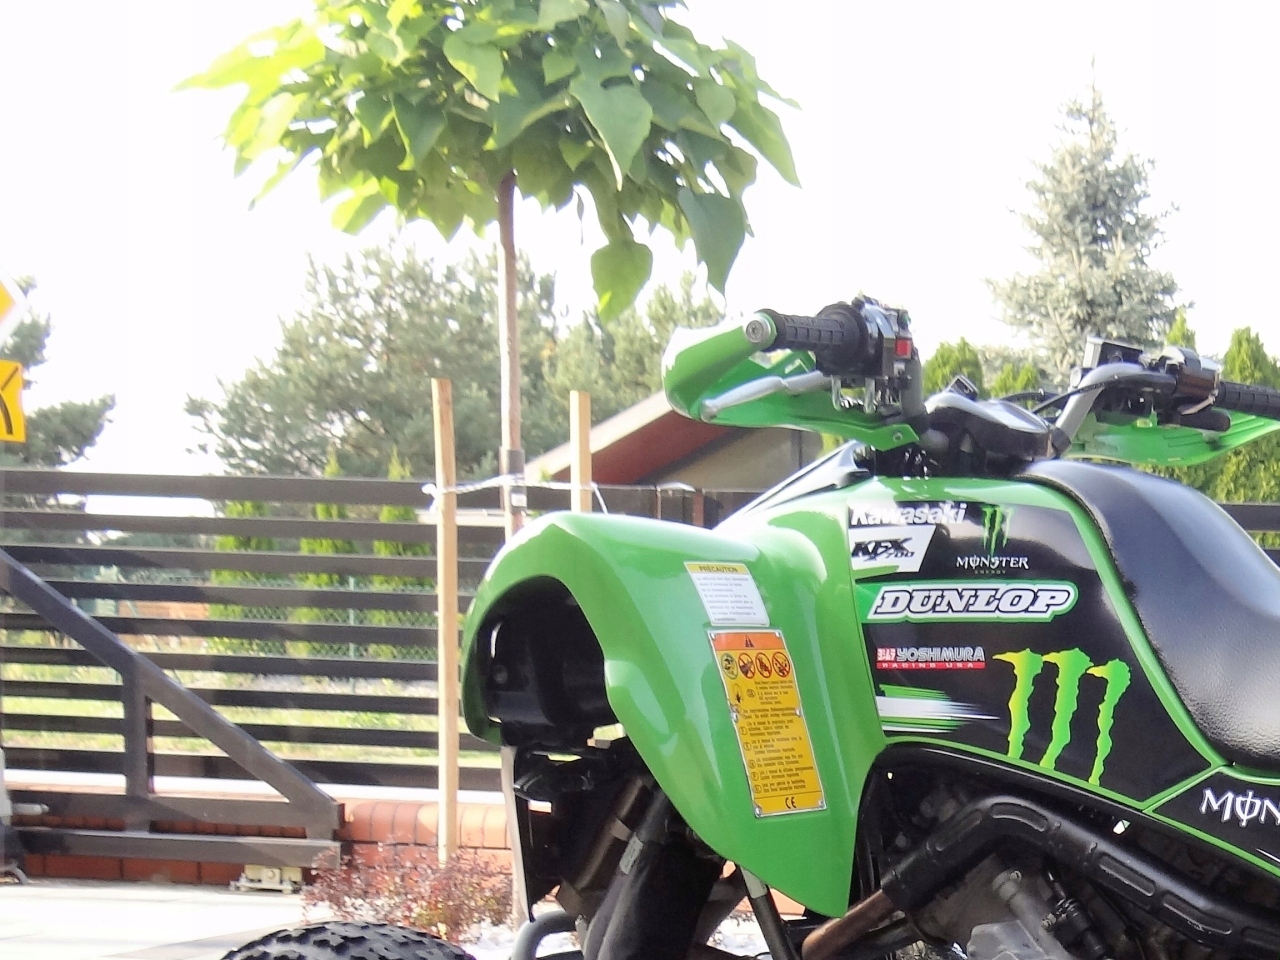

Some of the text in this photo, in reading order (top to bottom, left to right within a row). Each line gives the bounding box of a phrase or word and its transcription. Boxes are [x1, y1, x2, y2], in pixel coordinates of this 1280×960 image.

[851, 503, 968, 525] Kawasaki
[851, 537, 915, 561] KFX 700
[874, 587, 1073, 615] DUNLOP
[897, 646, 985, 661] YOSHIMURA
[784, 797, 797, 809] CE
